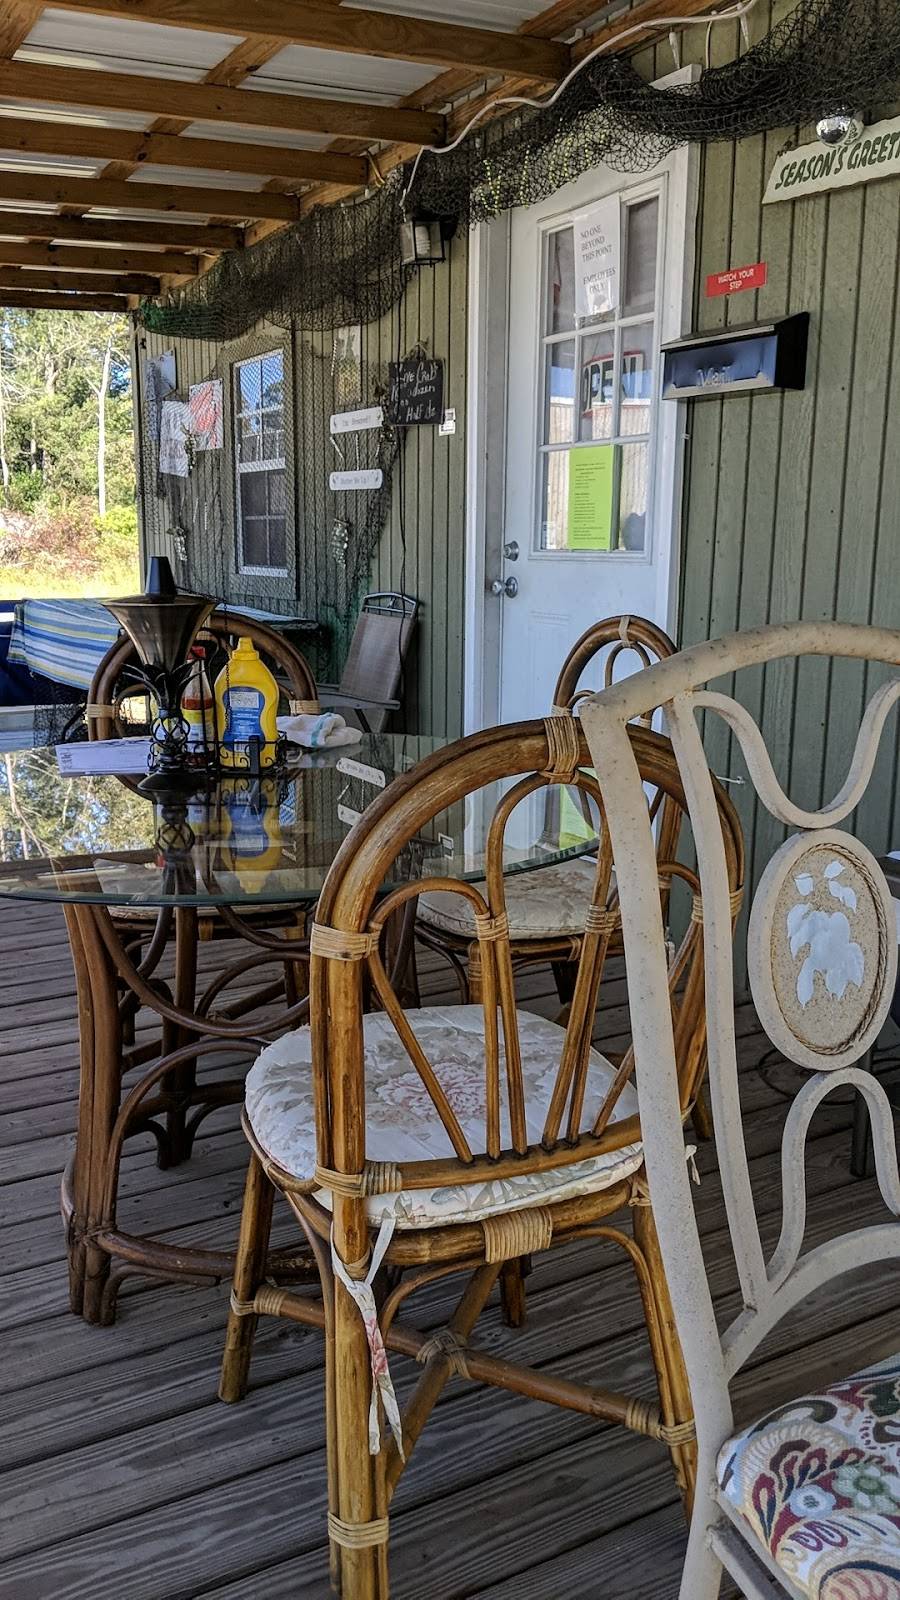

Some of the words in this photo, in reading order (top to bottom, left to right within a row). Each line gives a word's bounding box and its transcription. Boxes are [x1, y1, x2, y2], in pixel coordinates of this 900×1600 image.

[775, 147, 848, 190] SEASON'S
[580, 230, 589, 239] NO
[589, 224, 602, 236] ONE
[581, 236, 605, 251] BEYOND
[582, 250, 594, 262] THIS
[595, 244, 612, 256] POINT
[583, 266, 616, 285] EMPLOYEES
[718, 273, 737, 284] WATCH
[739, 268, 754, 279] YOUR
[729, 280, 743, 290] STEP
